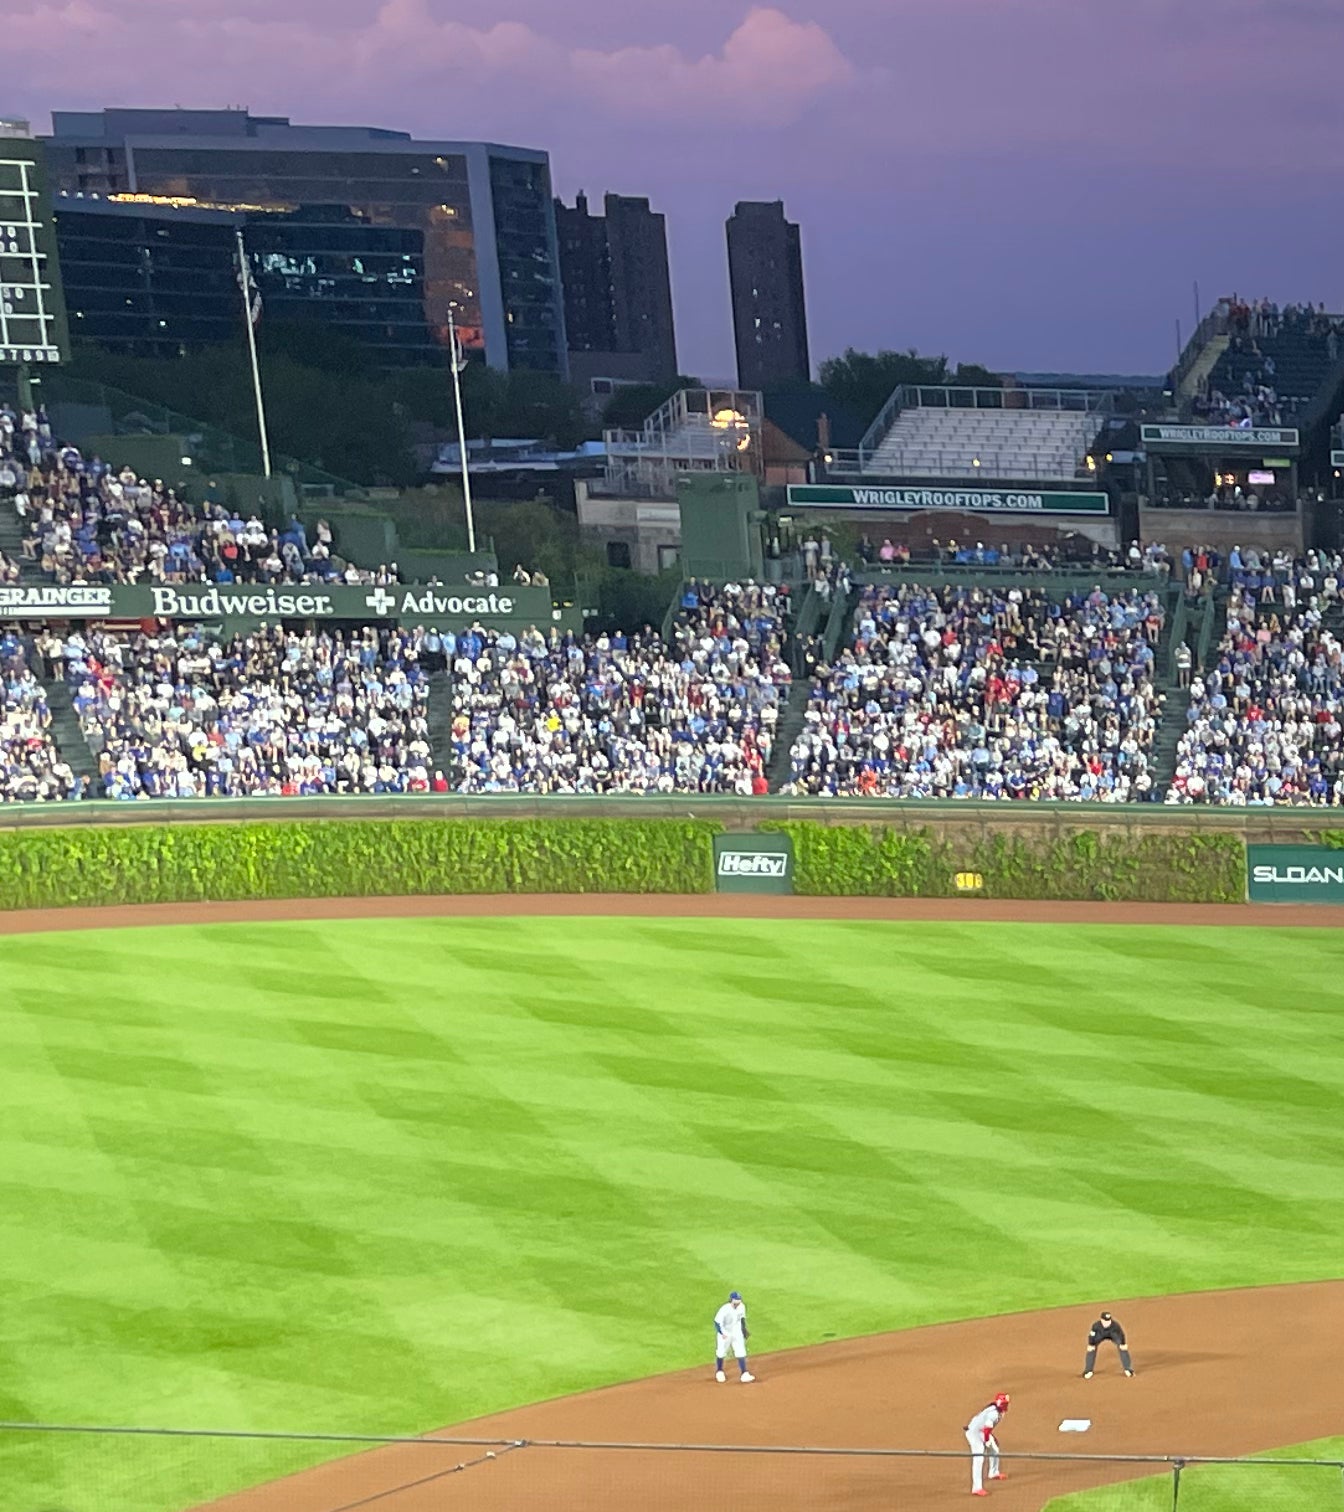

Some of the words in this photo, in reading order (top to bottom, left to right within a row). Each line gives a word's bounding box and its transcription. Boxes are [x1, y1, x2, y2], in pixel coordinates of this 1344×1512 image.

[853, 490, 1043, 508] WRIGLEYROOFTOPS.COM
[151, 587, 328, 616] Budweiser
[401, 591, 513, 614] Advocate
[723, 855, 784, 874] Hefty
